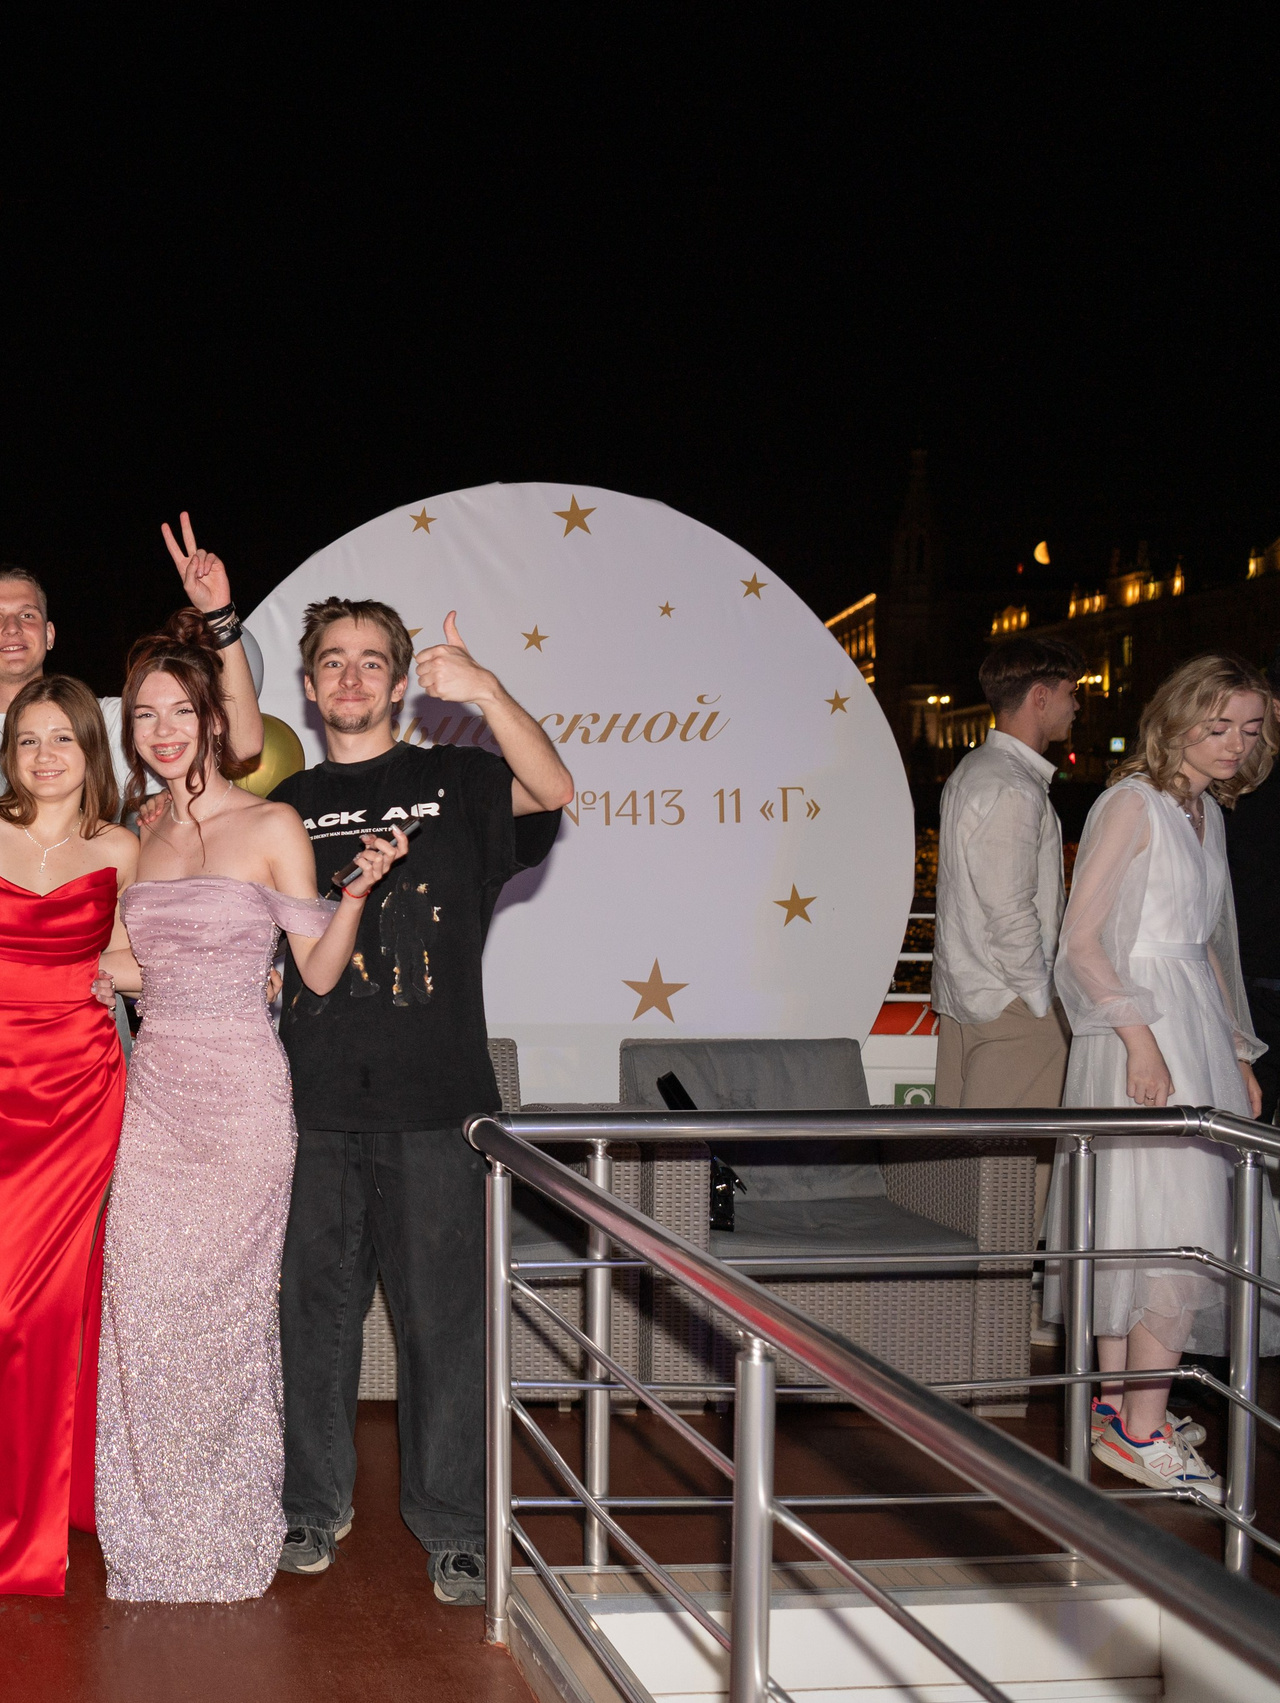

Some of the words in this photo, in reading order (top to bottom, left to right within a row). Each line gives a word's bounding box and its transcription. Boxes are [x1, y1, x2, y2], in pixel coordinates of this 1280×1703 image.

[713, 788, 741, 824] 11
[759, 786, 821, 823] «Г»
[303, 809, 367, 830] ACK
[1149, 1453, 1183, 1477] N
